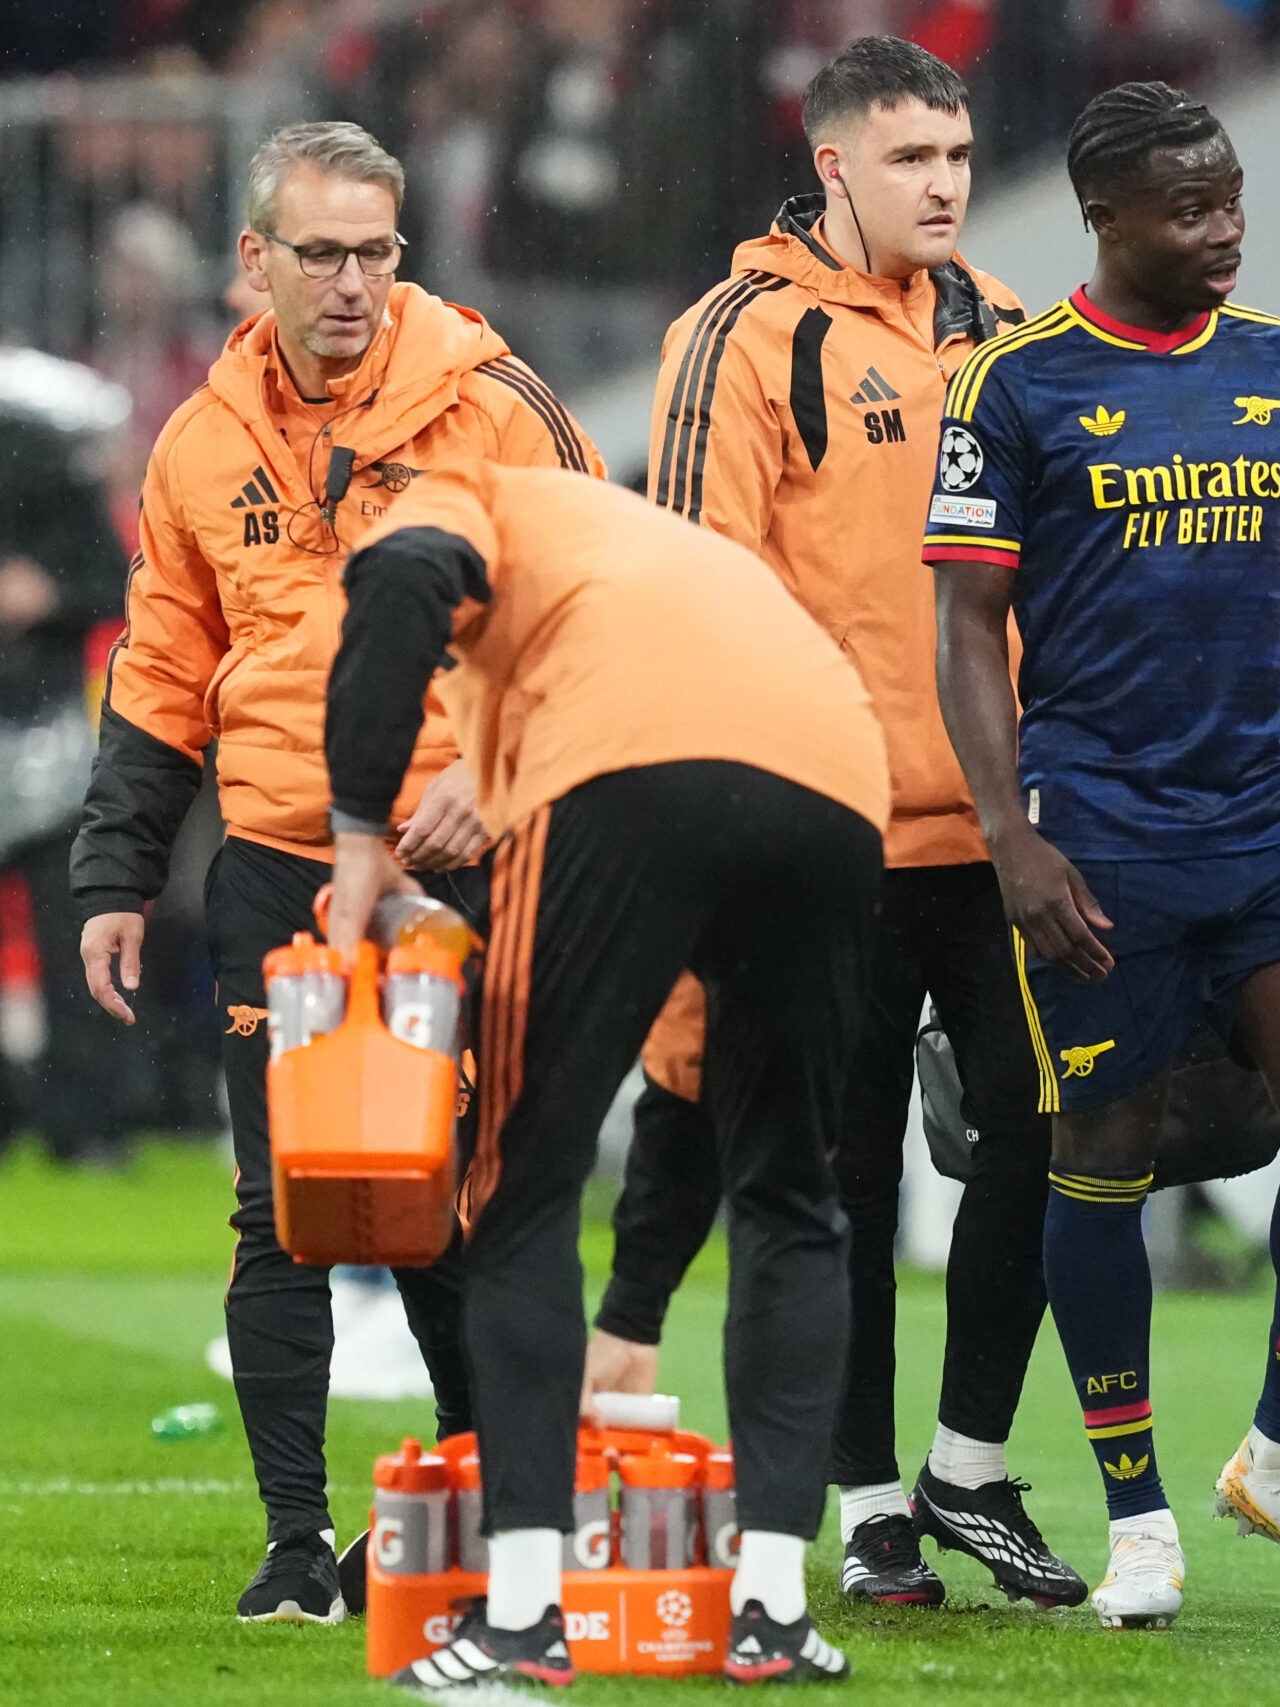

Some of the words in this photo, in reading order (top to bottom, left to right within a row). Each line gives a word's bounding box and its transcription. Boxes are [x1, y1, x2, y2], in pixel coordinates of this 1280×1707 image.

[863, 408, 907, 445] SM
[243, 510, 280, 547] AS
[1122, 509, 1169, 549] FLY
[1177, 505, 1264, 545] BETTER
[1087, 1370, 1138, 1396] AFC
[376, 1517, 405, 1567] G
[573, 1519, 611, 1570] G
